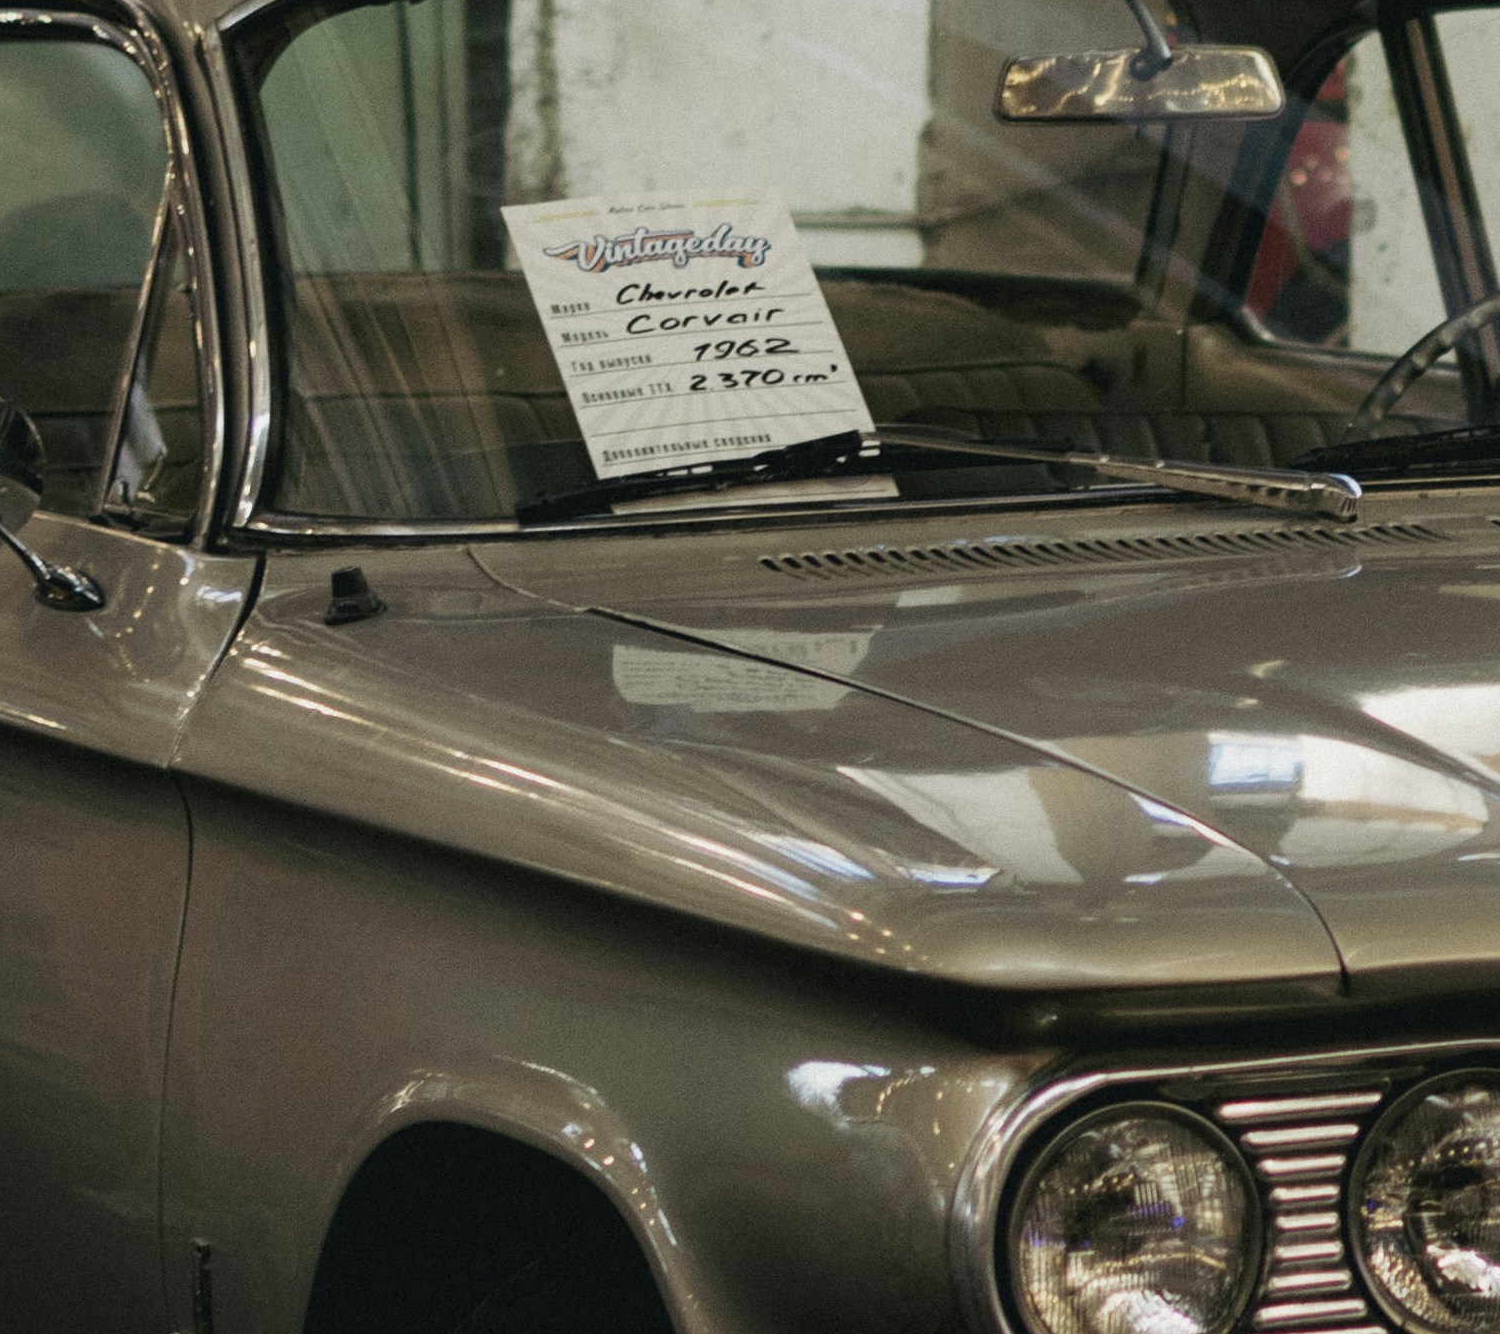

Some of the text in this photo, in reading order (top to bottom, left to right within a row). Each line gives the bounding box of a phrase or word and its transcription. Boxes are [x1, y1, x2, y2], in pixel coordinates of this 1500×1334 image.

[543, 222, 770, 273] Vintageday
[616, 280, 765, 305] Chevrolet
[626, 308, 784, 335] Corvair
[694, 338, 799, 361] 1962
